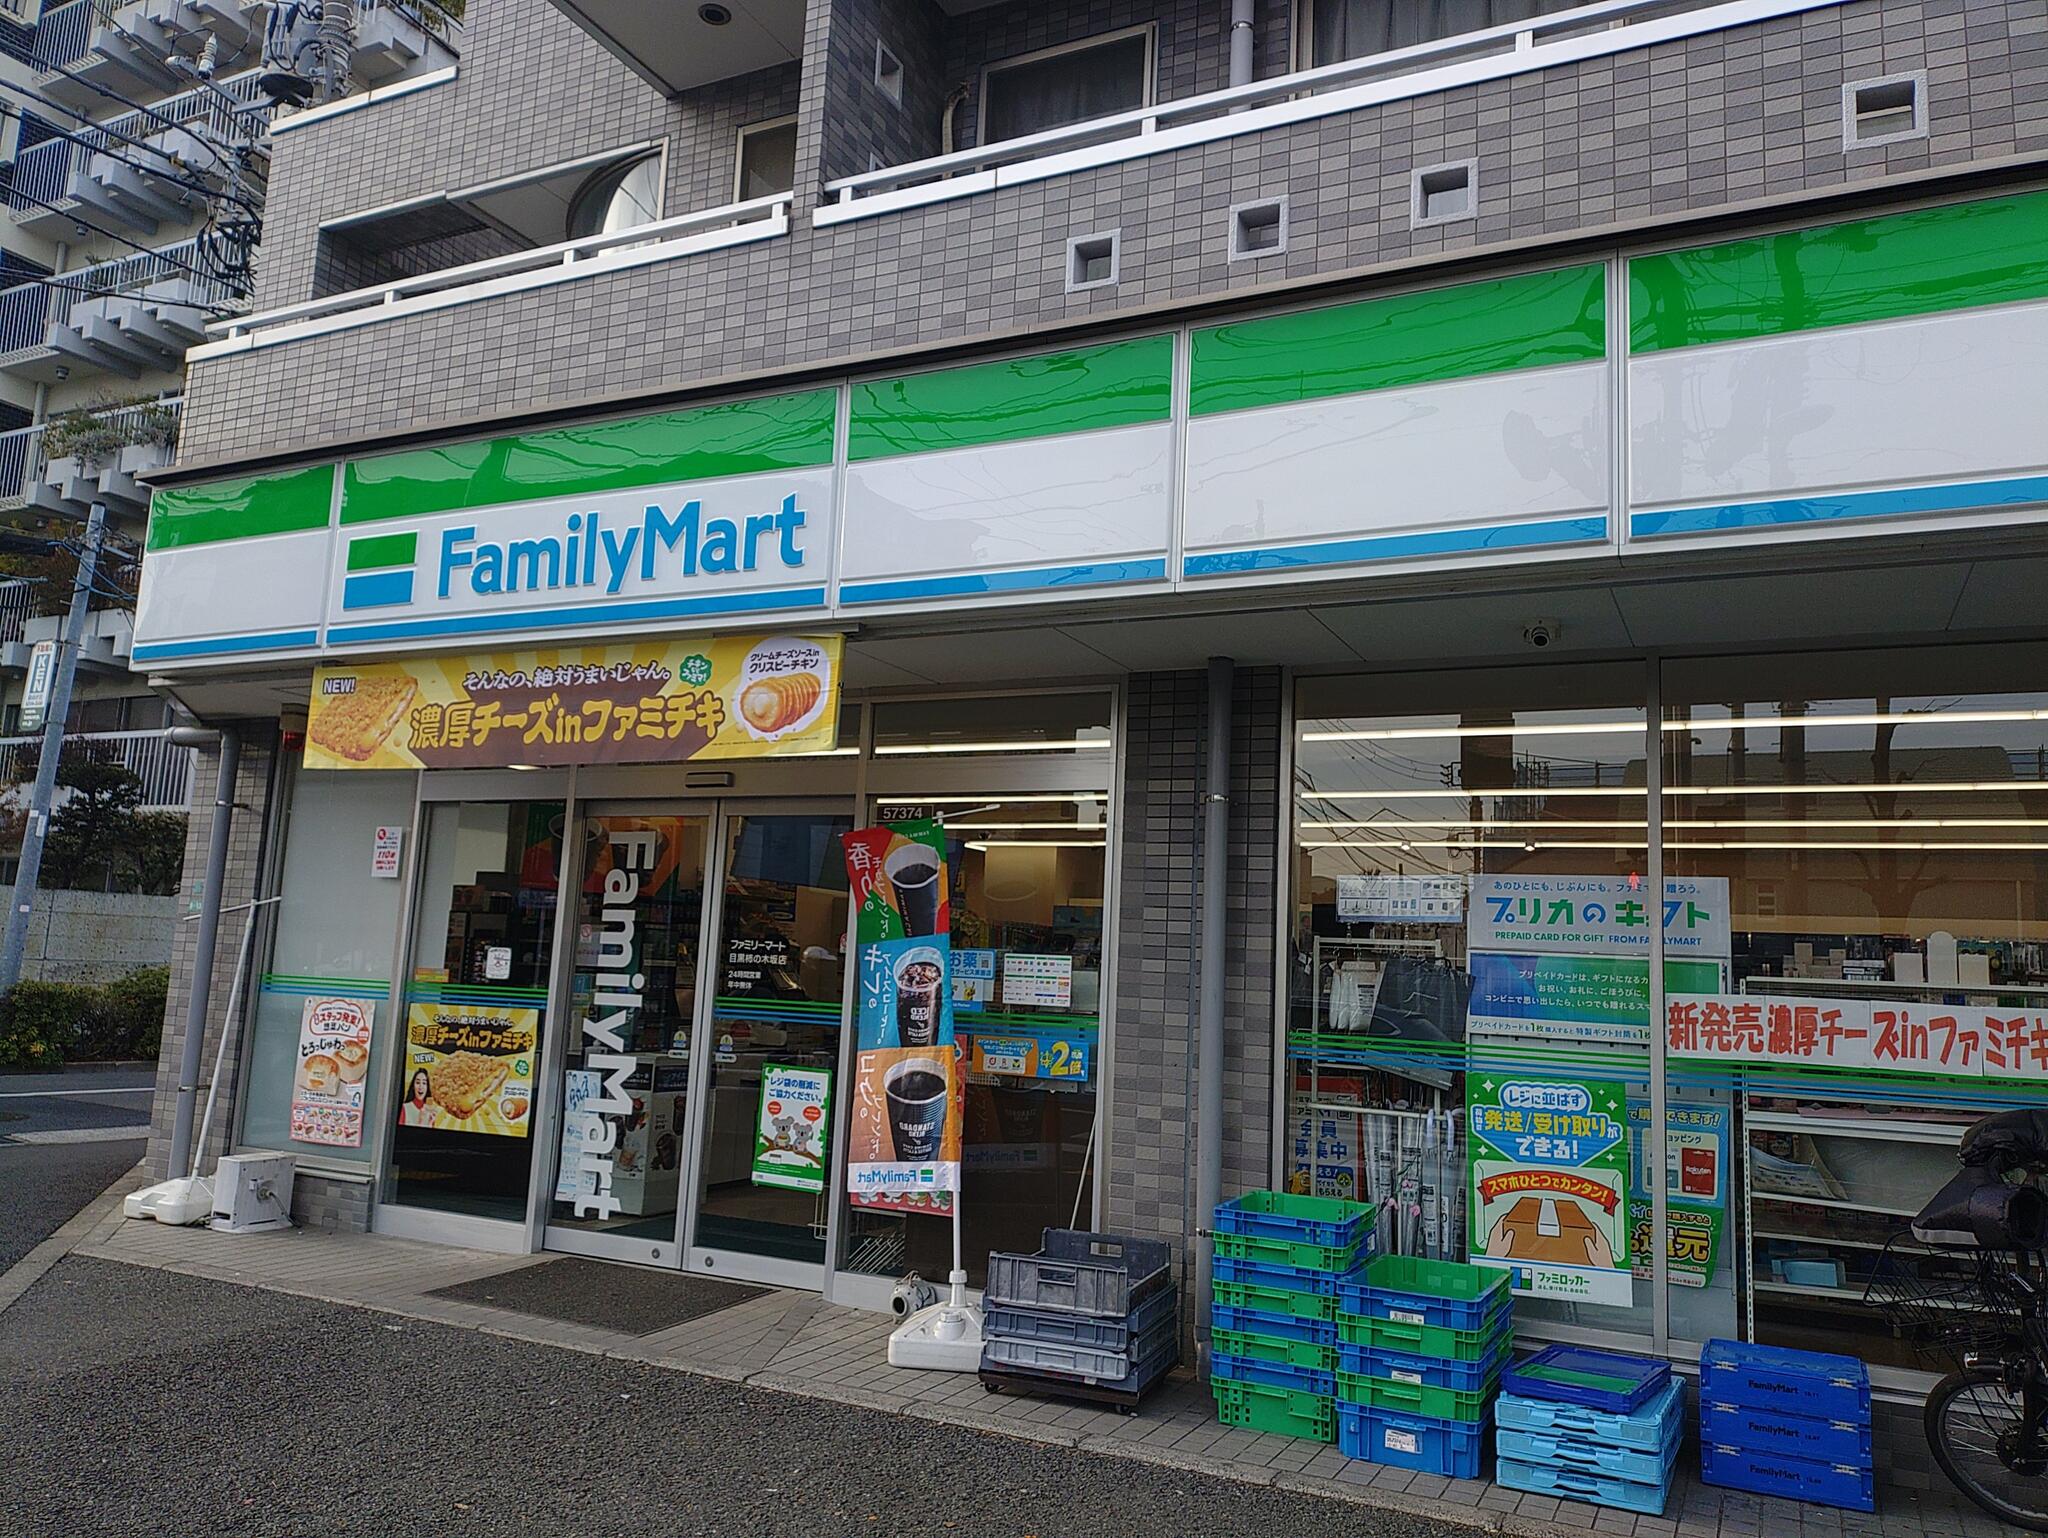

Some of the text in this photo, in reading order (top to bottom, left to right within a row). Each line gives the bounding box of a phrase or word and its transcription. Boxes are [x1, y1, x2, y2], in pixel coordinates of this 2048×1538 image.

[437, 492, 806, 600] FamilyMart
[750, 648, 820, 661] クリームチーズソースin
[33, 655, 49, 692] KEN
[750, 659, 819, 673] クリスピーチキン
[323, 676, 355, 695] NEW!
[463, 663, 671, 691] そんなの、絶対うまいじゃん。
[407, 690, 725, 751] 濃厚チーズinファミチキ
[883, 807, 923, 819] 57374
[730, 939, 787, 952] ファミリーマート
[1495, 931, 1702, 946] PREPAID CARD FOR GIFT FROM FALYMART
[1519, 970, 1649, 984] プリペイドカードは、ギフトになるカ
[573, 831, 656, 1221] FamilyMart
[411, 1024, 534, 1051] 濃厚チーズinファミチキ
[413, 1052, 435, 1064] NEW!
[770, 1077, 821, 1090] レジ袋の削減に
[768, 1088, 822, 1102] ご協力ください。
[1508, 1089, 1584, 1107] レジに並ばず
[1515, 1135, 1579, 1160] できる!
[1488, 1174, 1610, 1202] スマホひとつでカンタン!
[1537, 1271, 1591, 1286] ファミロッカー
[1748, 1379, 1800, 1394] FamilyMart
[1748, 1421, 1800, 1438] FamilyMart
[1749, 1464, 1801, 1481] FamilyMart
